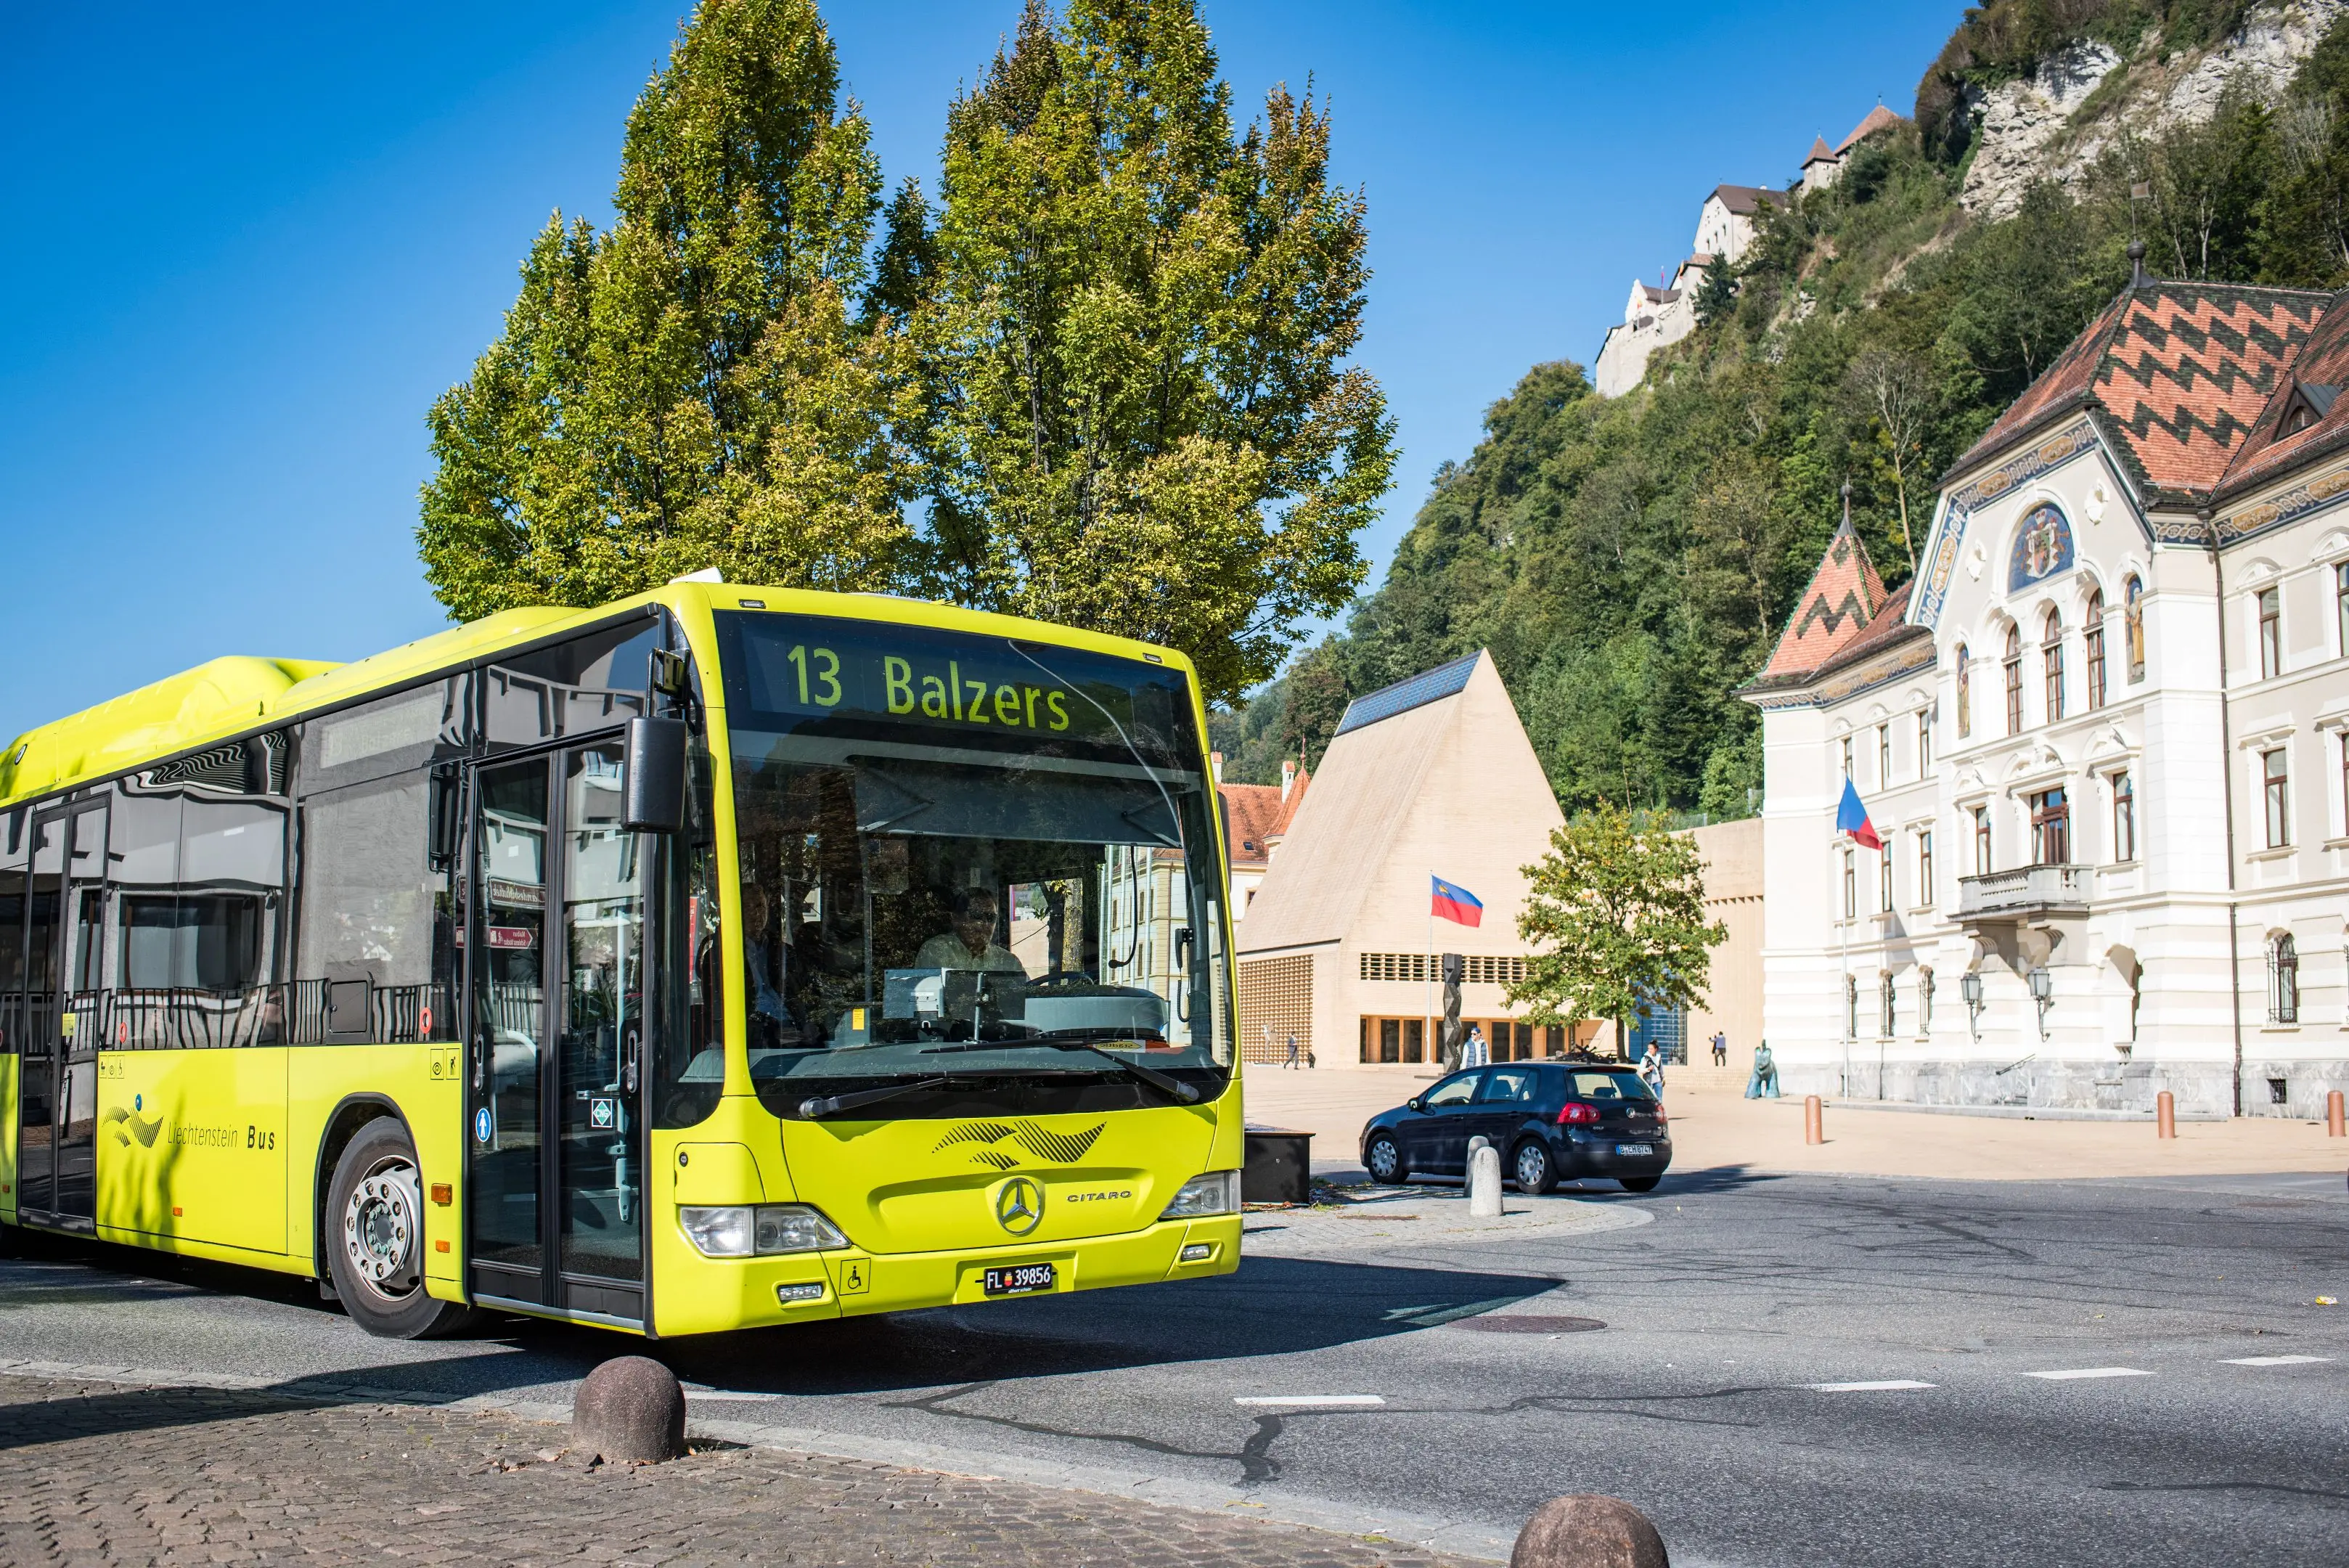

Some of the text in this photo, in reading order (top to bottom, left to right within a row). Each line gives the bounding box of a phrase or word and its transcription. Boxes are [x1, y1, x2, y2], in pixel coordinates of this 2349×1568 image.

[787, 644, 1069, 732] 13 Balzers
[595, 1109, 609, 1118] CNG
[168, 1121, 275, 1151] Liechtenstein Bus
[1066, 1191, 1132, 1203] CITARO
[987, 1266, 1051, 1289] FL 39856
